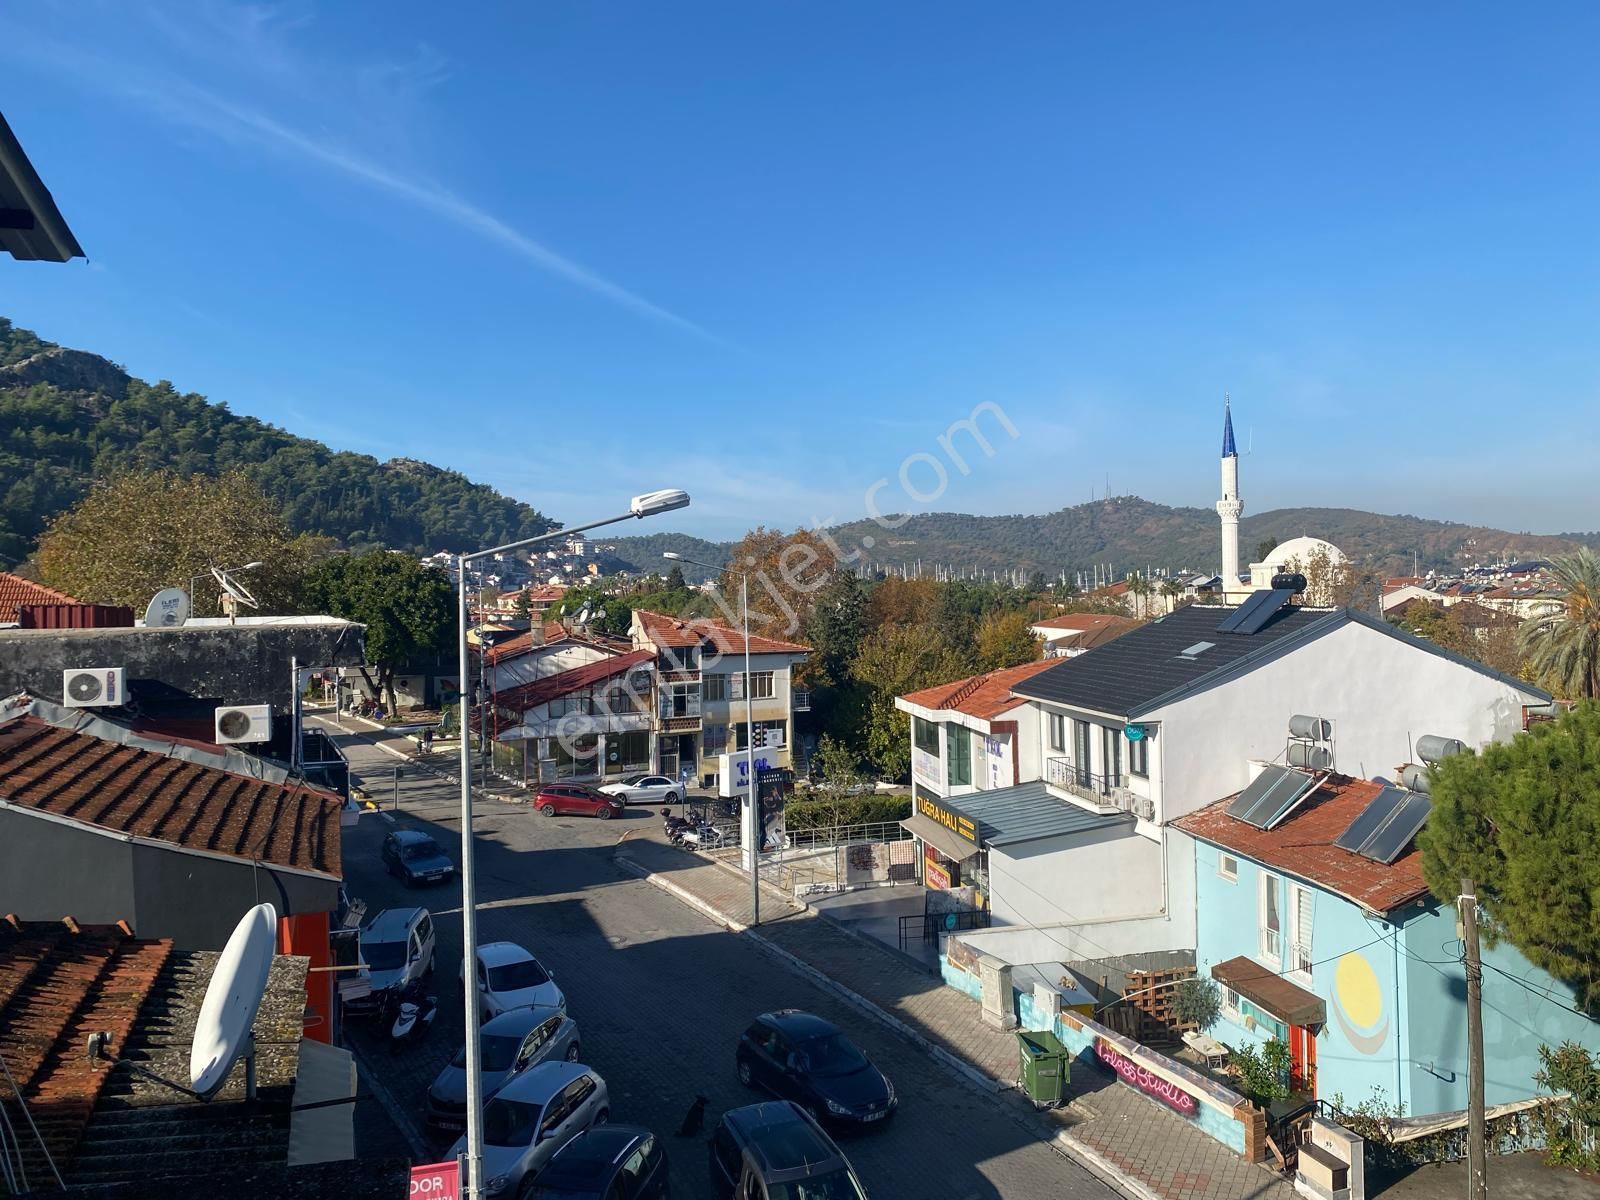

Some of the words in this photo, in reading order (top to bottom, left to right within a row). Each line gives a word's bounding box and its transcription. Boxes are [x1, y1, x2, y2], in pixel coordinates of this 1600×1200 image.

[916, 796, 940, 822] TUĞRA
[940, 809, 957, 832] HALI
[1136, 1066, 1193, 1108] Studio
